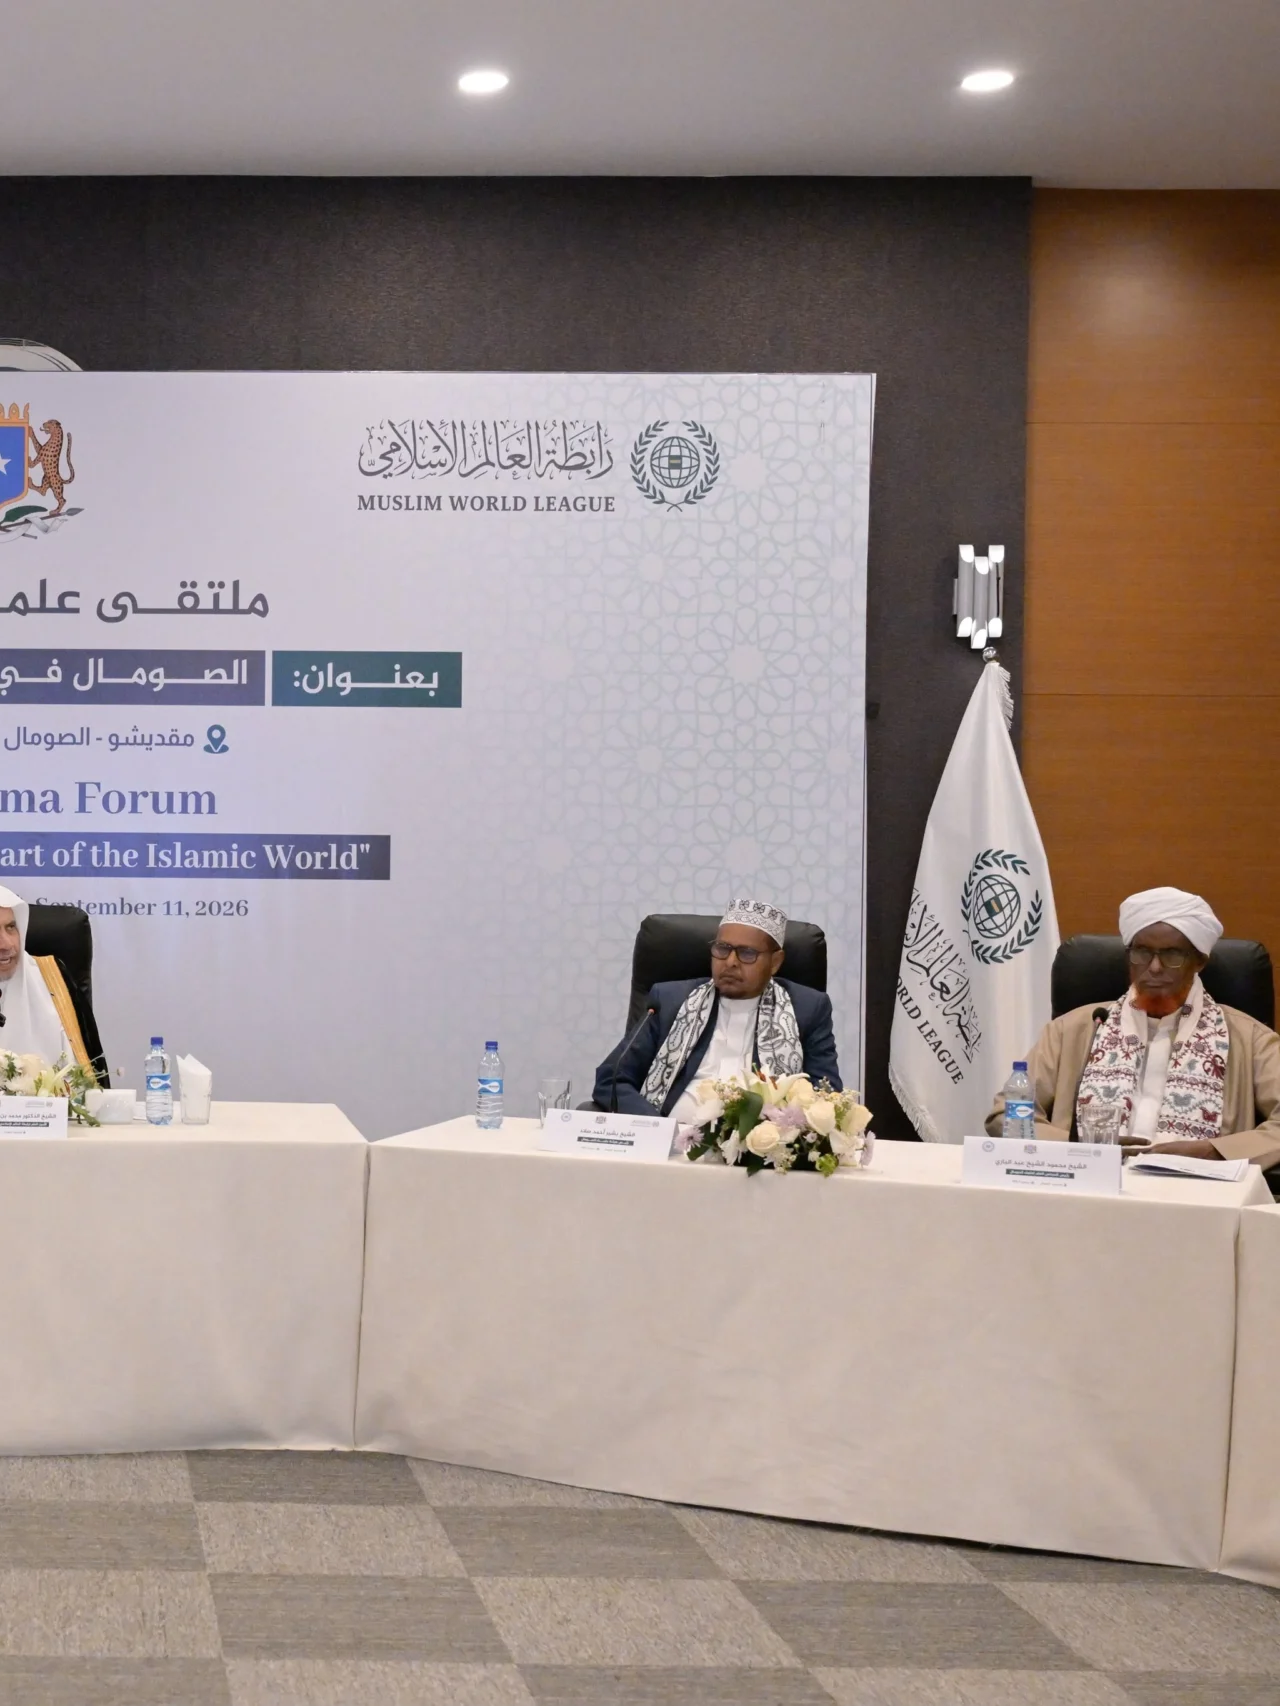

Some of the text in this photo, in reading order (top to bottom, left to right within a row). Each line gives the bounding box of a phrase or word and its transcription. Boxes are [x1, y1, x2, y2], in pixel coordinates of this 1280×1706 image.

[357, 495, 615, 512] MUSLIM WORLD LEAGUE
[97, 579, 269, 624] ملتقى
[72, 657, 248, 692] الصومال
[293, 662, 439, 697] بعنوان:
[3, 726, 91, 752] الصومال
[107, 724, 195, 752] مقديشو
[75, 781, 219, 815] Forum
[52, 841, 86, 868] of
[89, 841, 139, 868] the
[146, 842, 257, 869] Islamic
[263, 843, 371, 870] World"
[162, 900, 190, 918] 11,
[195, 900, 249, 917] 2026
[916, 1019, 964, 1084] LEAGUE
